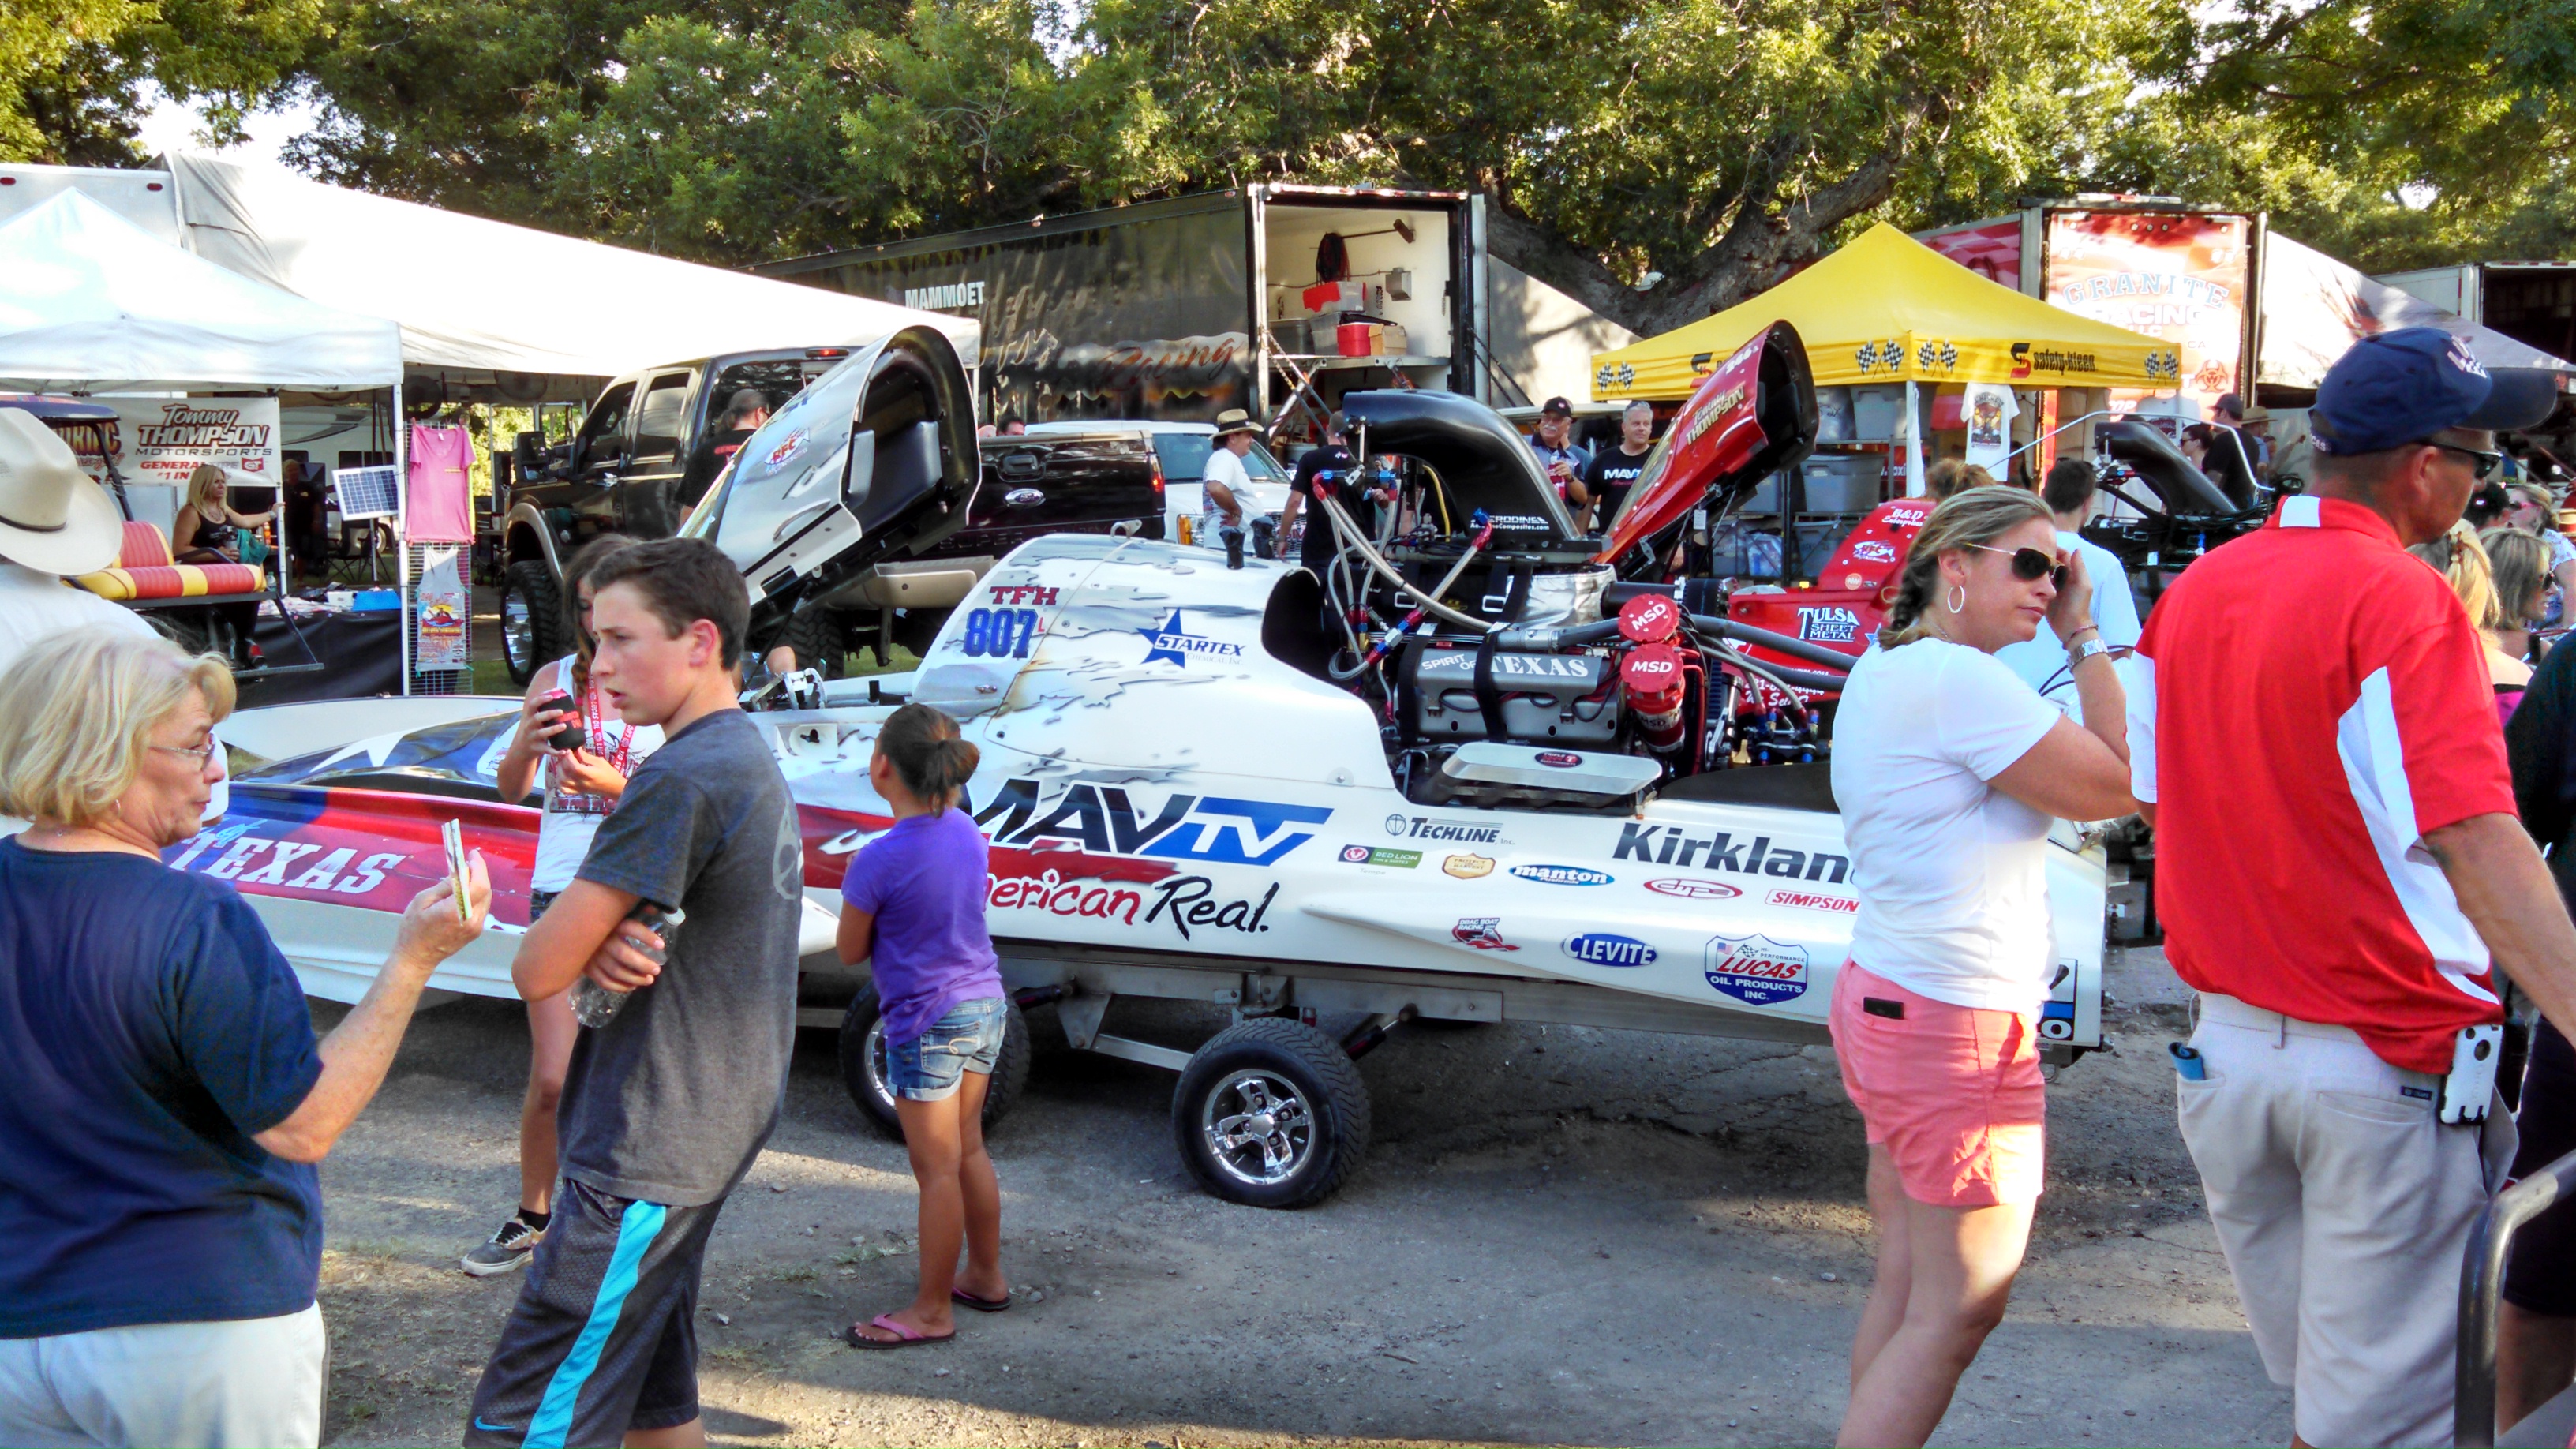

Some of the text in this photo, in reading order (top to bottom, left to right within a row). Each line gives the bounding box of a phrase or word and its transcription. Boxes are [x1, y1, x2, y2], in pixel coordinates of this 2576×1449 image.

[904, 281, 985, 311] MAMMOET
[2063, 272, 2230, 308] GRANITE
[2095, 304, 2206, 326] ACING
[1096, 337, 1245, 392] Racing
[2033, 348, 2096, 376] safety-kleen
[162, 402, 241, 434] Tommy
[1685, 385, 1746, 445] THOMPSON
[1692, 389, 1728, 425] Tommy
[138, 425, 271, 447] THOMPSON
[135, 447, 273, 456] MOTORSPORTS
[1892, 508, 1924, 520] B&D
[989, 586, 1060, 606] TFH
[1631, 602, 1668, 631] MSD
[1797, 607, 1859, 635] TULSA
[1810, 623, 1859, 632] SHEET
[964, 608, 1039, 658] 807
[1155, 636, 1247, 657] STARTEX
[1421, 653, 1466, 671] SPIRIT
[1491, 656, 1589, 677] TEXAS
[1631, 661, 1673, 673] MSD
[168, 833, 407, 893] TEXAS
[1612, 822, 1856, 884] Kirklan
[1513, 866, 1608, 885] manton
[987, 869, 1280, 940] erican Real.
[1772, 892, 1861, 912] SIMPSON
[1563, 932, 1656, 964] CLEVITE
[1760, 953, 1806, 962] PERFORMANCE
[1717, 956, 1803, 979] LUCAS
[1709, 975, 1803, 994] OIL PRODUCTS
